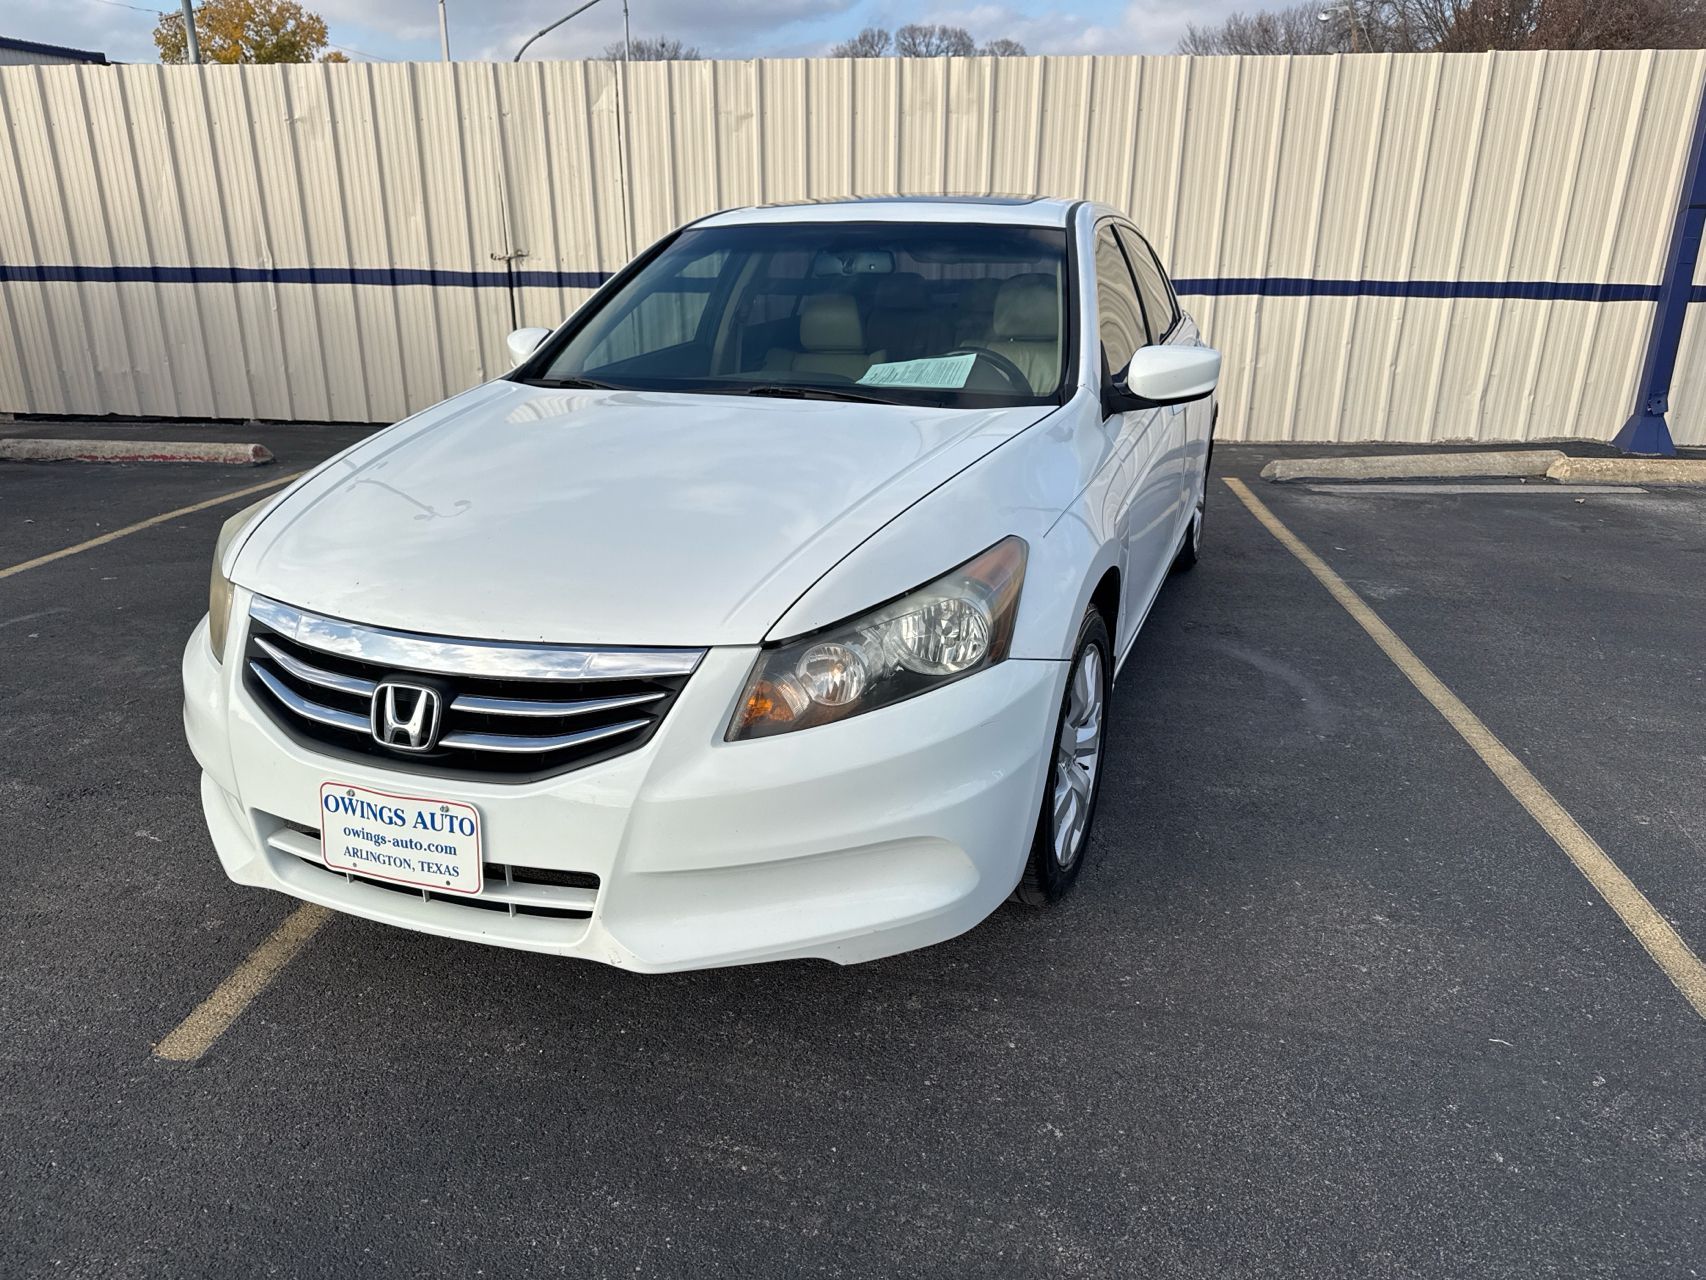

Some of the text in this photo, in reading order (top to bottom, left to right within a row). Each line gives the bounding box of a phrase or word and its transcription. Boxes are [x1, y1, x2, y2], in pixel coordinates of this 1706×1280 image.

[324, 794, 475, 836] OWINGS AUTO
[343, 826, 457, 856] owings-auto.com
[343, 846, 460, 877] ARLINGTON, TEXAS
